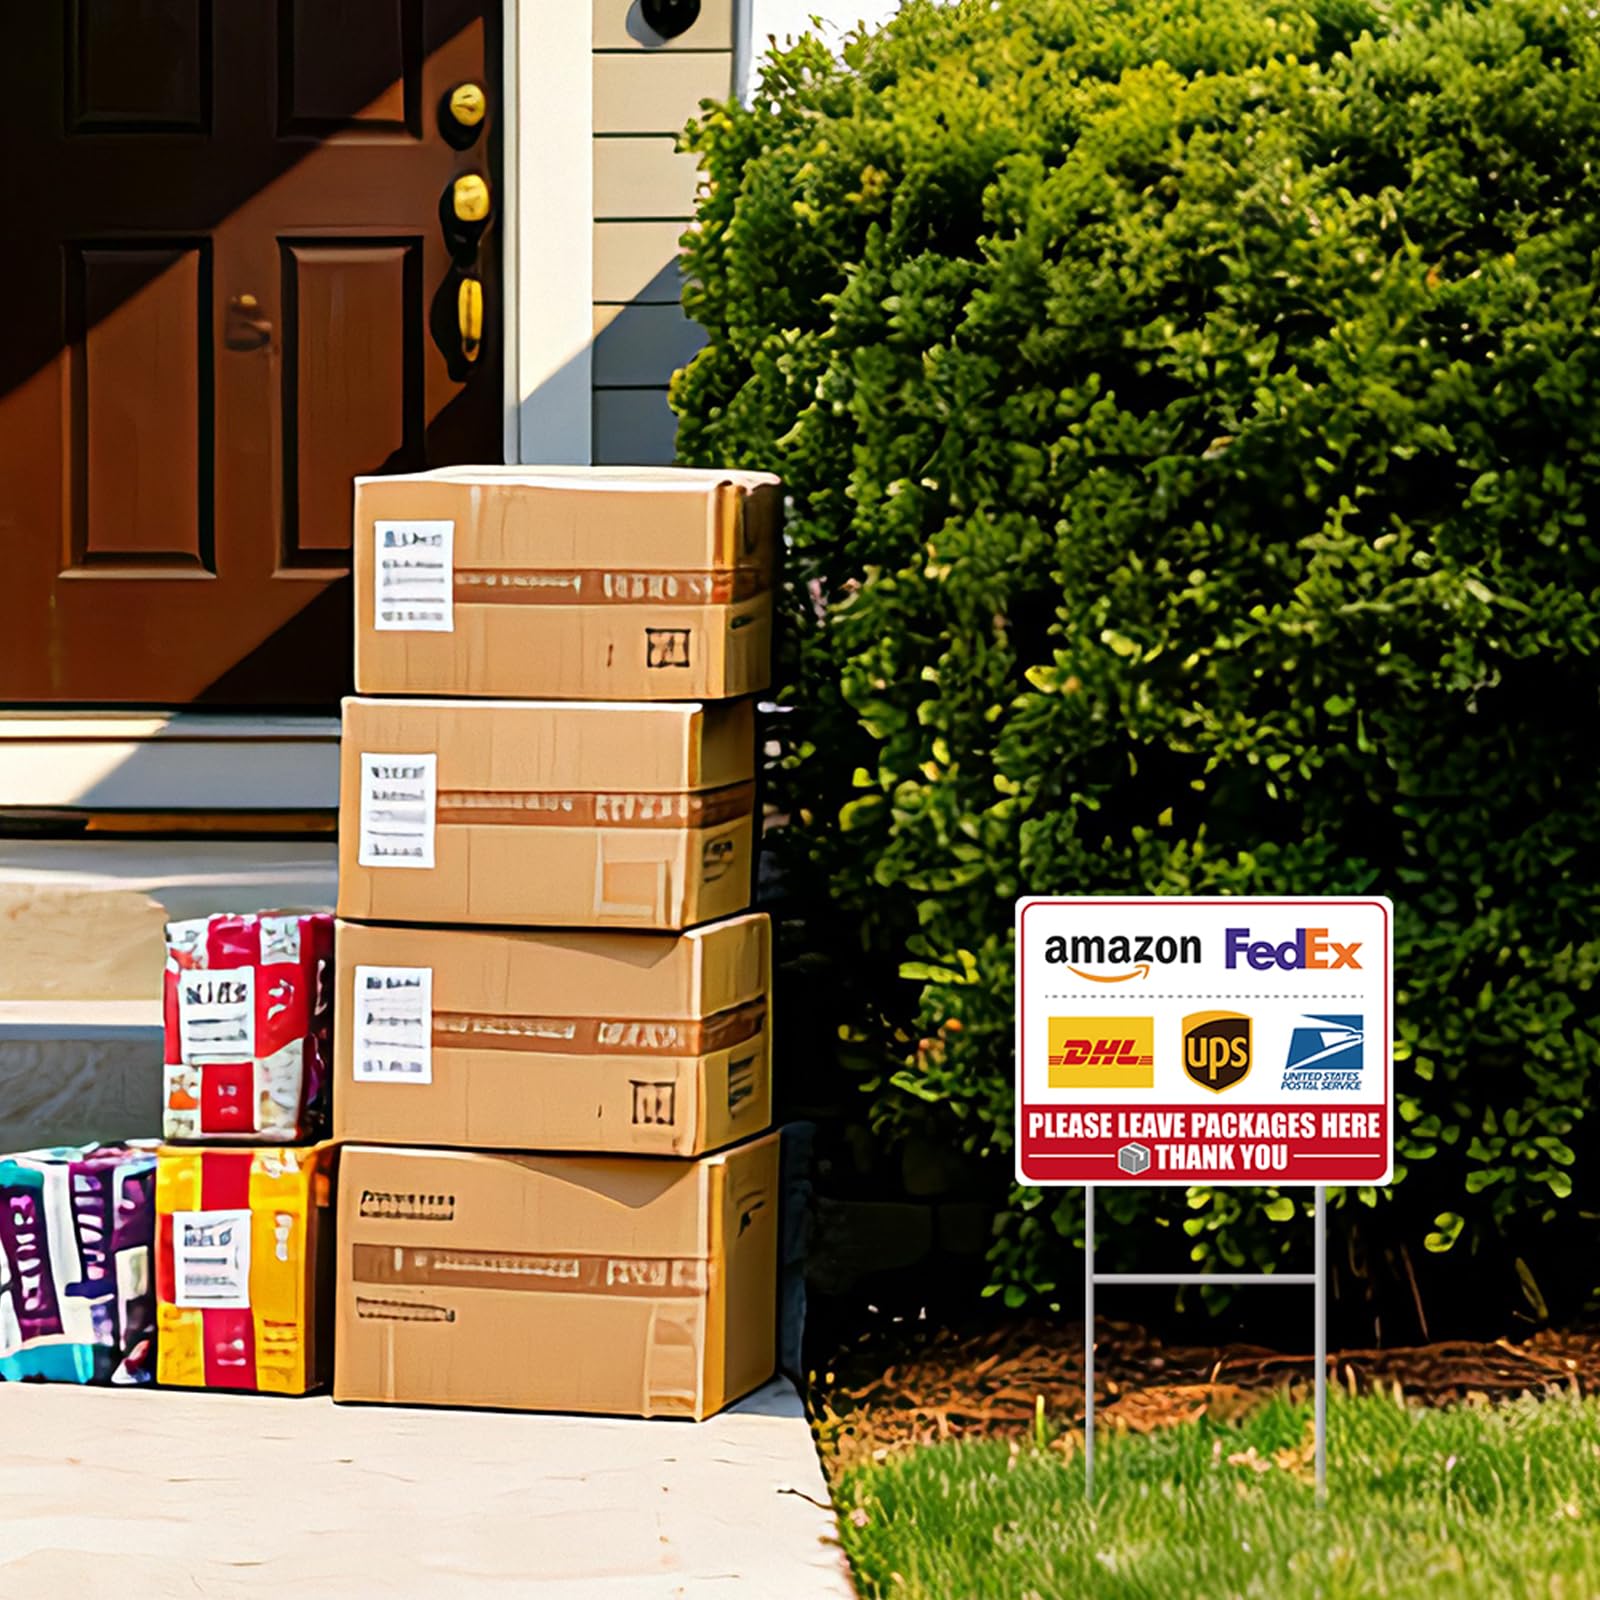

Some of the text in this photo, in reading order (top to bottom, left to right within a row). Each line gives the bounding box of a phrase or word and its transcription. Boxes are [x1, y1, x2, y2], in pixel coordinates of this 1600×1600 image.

[1045, 928, 1363, 971] amazon FedEx
[1063, 1039, 1141, 1066] DHL
[1187, 1036, 1248, 1080] ups
[1280, 1081, 1362, 1090] POSTAL SERVICE
[1282, 1072, 1359, 1081] UNITED STATES
[1029, 1112, 1381, 1139] PLEASE LEAVE PACKAGES HERE
[1154, 1144, 1288, 1171] THANK YOU
